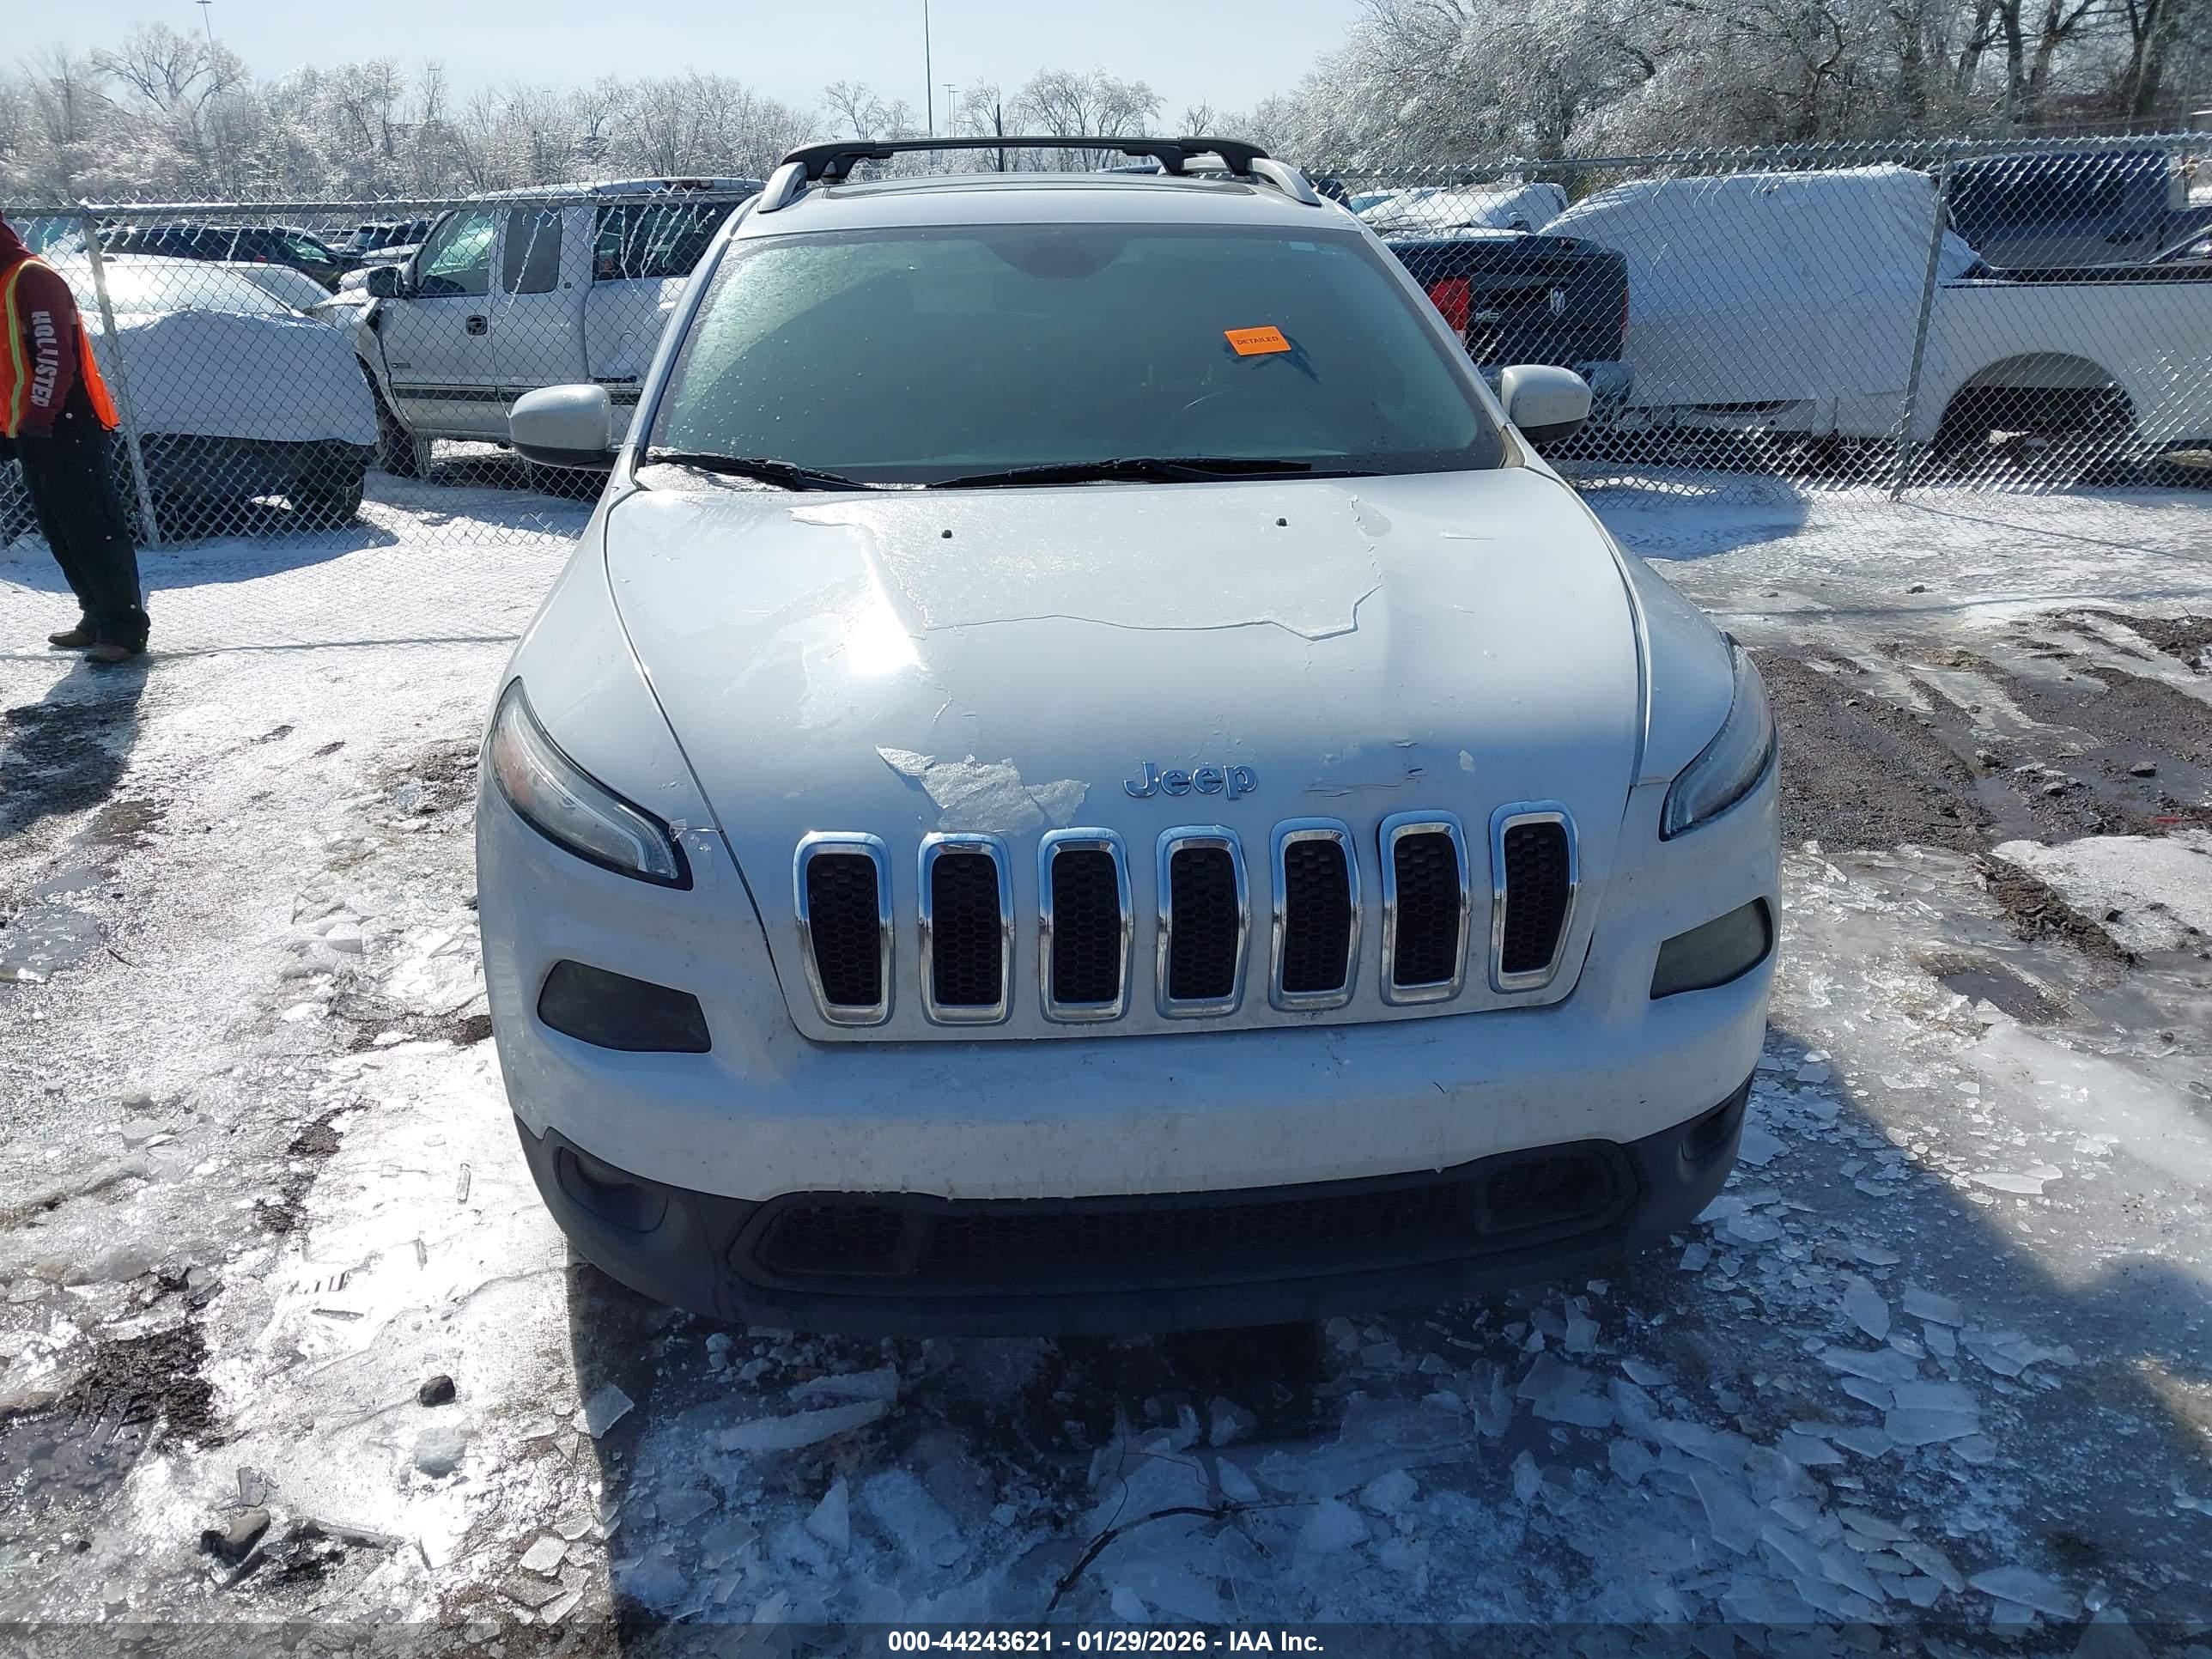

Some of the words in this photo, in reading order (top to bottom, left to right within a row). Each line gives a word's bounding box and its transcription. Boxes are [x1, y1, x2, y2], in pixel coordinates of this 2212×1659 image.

[30, 311, 58, 407] HOLLISTER
[1237, 336, 1279, 345] DETAILED
[1123, 761, 1257, 800] Jeep
